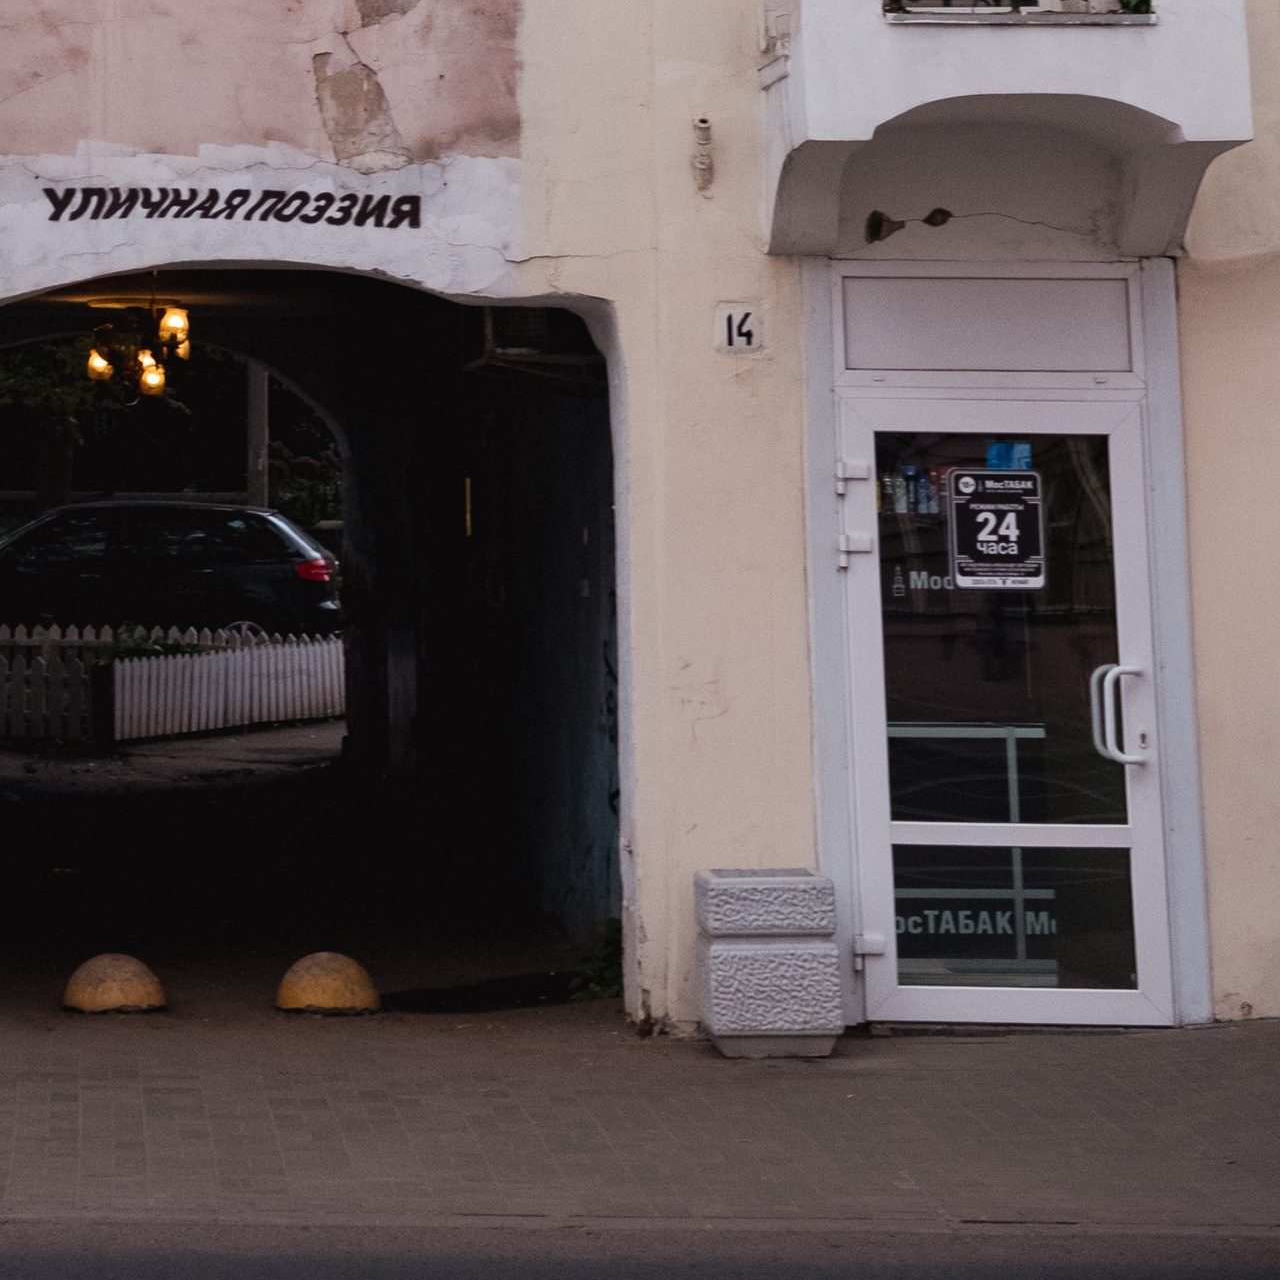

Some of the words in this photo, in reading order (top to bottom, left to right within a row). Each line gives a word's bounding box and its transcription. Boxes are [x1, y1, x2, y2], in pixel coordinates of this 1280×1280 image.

[42, 187, 251, 221] УЛИЧНАЯ
[243, 189, 422, 229] ПОЭЗИЯ
[727, 312, 753, 347] 14
[975, 511, 1020, 542] 24
[976, 542, 1018, 555] часа
